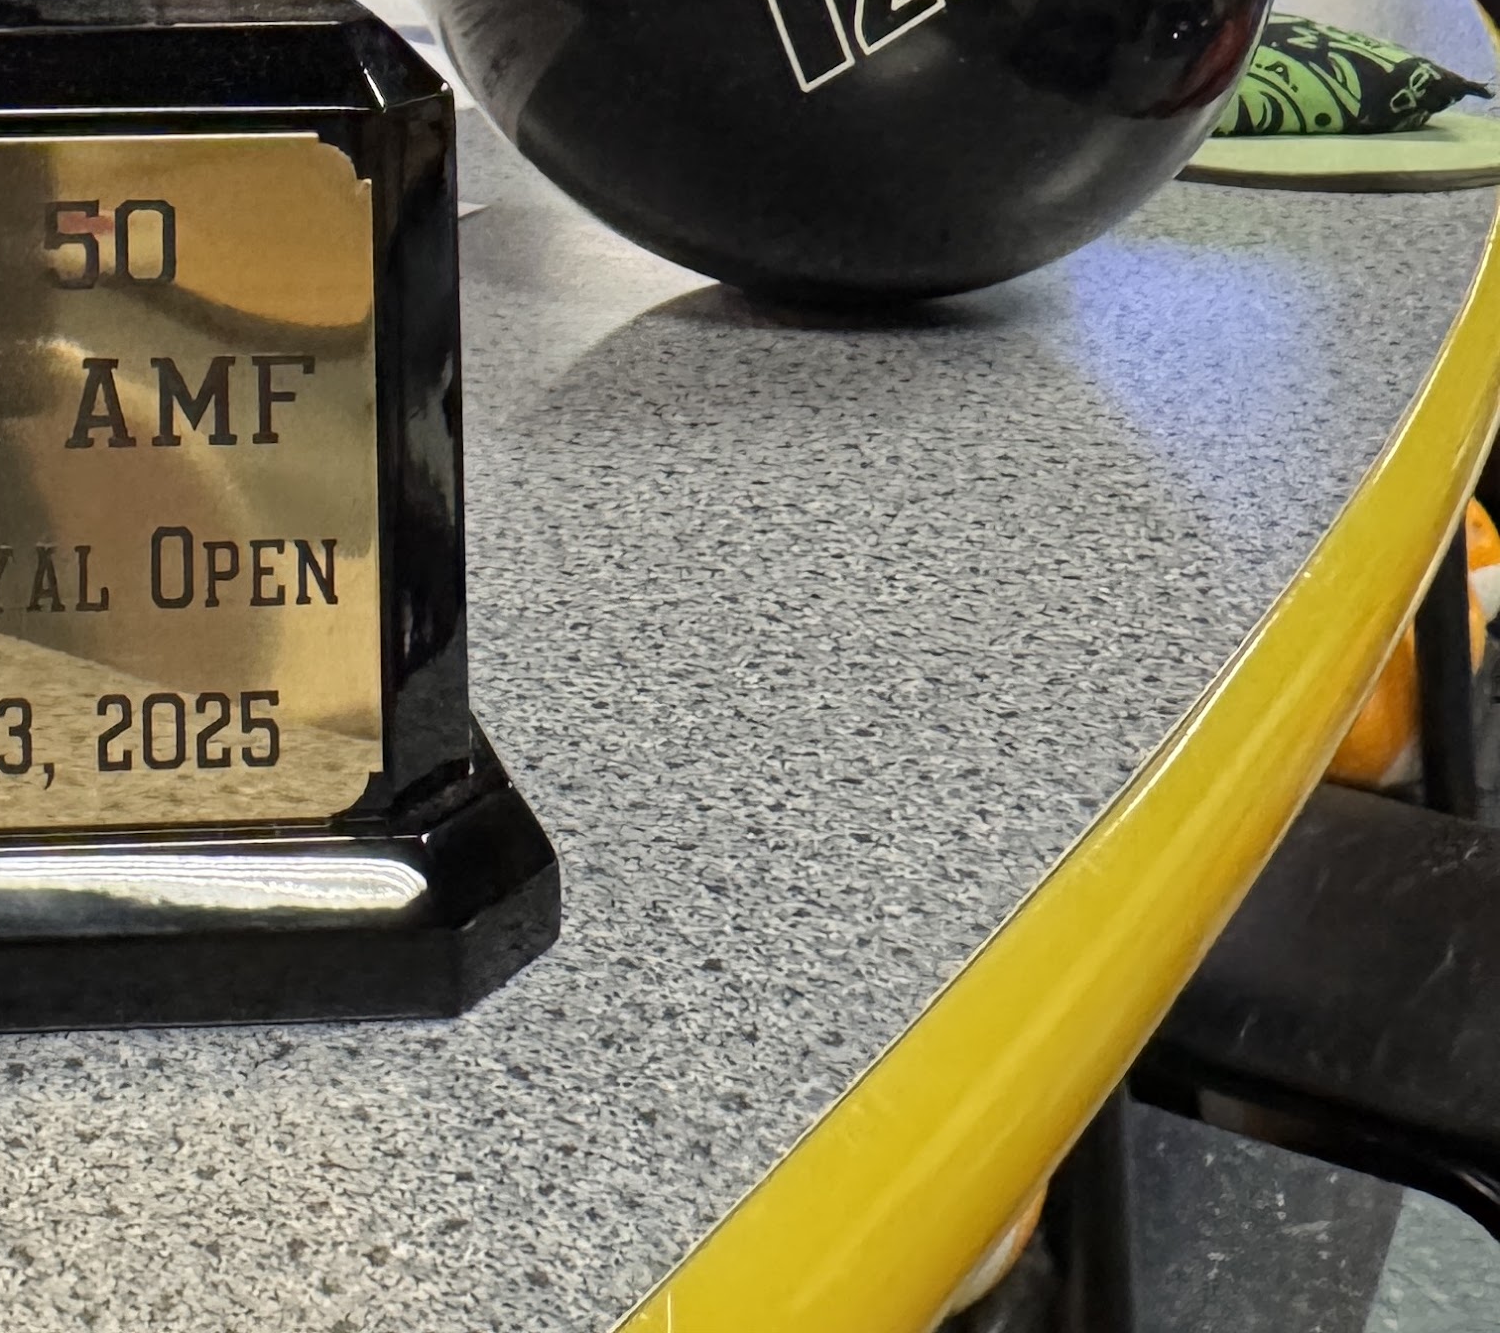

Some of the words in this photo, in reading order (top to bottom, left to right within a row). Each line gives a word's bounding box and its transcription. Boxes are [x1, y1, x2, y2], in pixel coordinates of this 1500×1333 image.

[43, 198, 178, 291] 50
[63, 353, 316, 450] AMF
[98, 689, 282, 773] 2025
